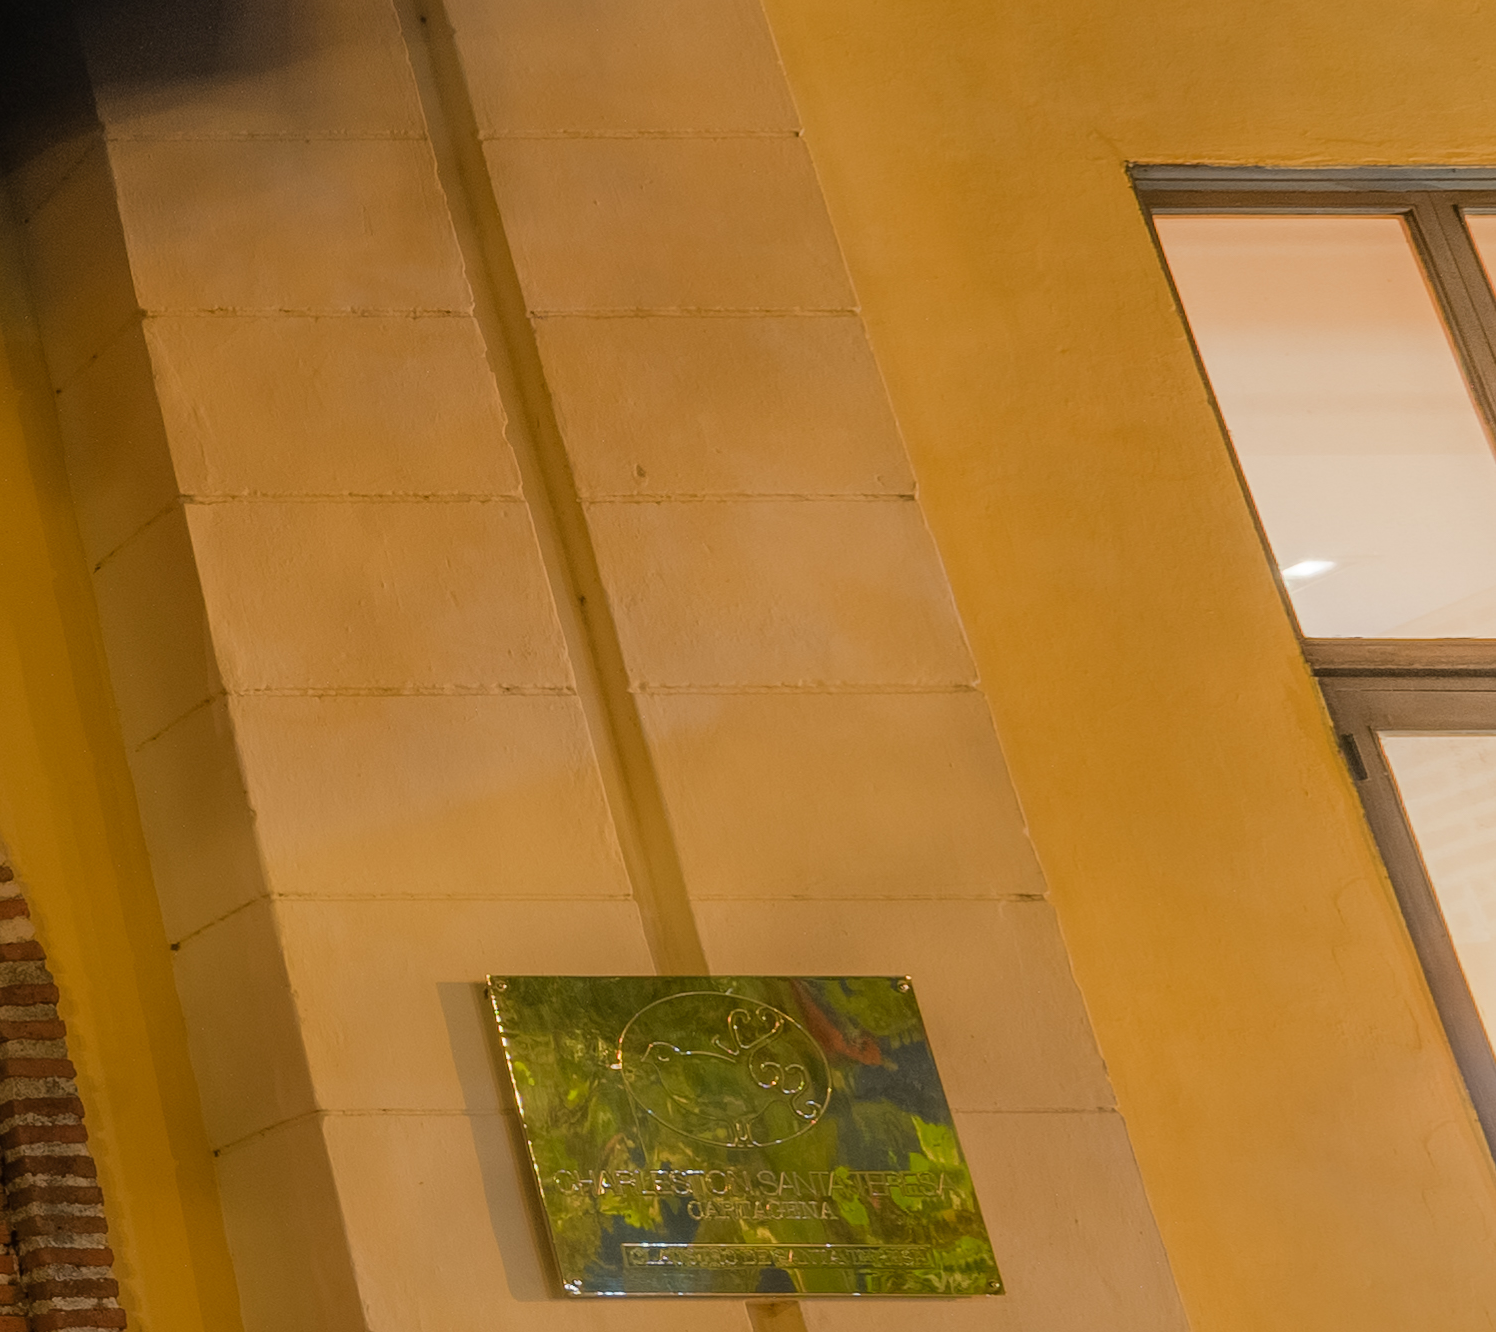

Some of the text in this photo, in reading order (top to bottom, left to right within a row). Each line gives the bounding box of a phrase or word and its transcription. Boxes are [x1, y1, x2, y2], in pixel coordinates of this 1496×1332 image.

[553, 1169, 960, 1198] CHARLESTON SANTA TERESA
[686, 1200, 839, 1221] CARTAGENA
